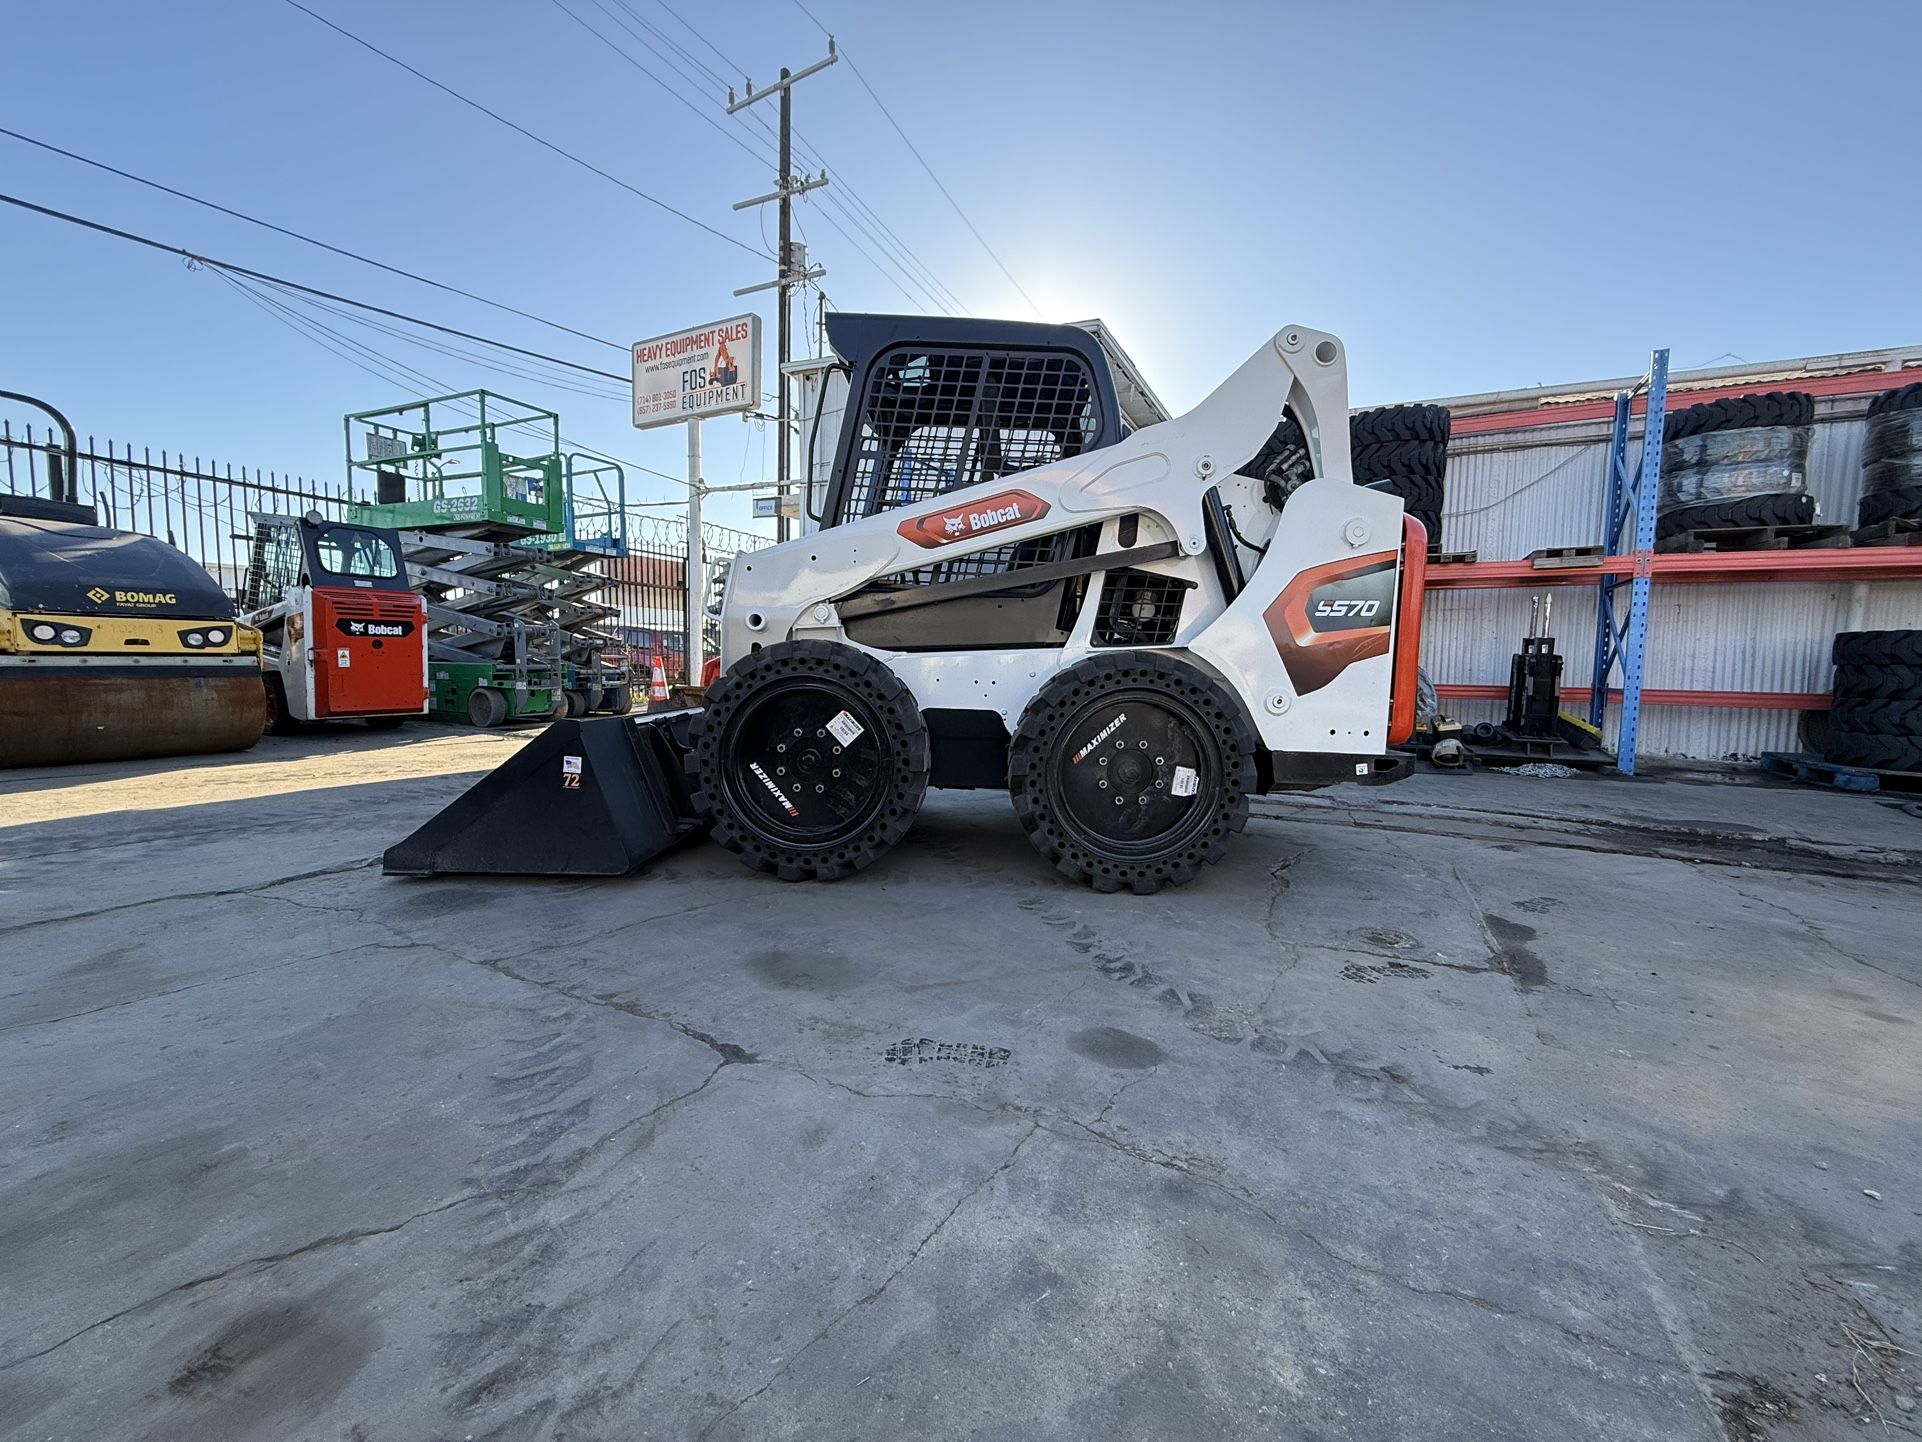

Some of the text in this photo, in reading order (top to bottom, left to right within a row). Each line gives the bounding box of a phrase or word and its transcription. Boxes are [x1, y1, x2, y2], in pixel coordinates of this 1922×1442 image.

[636, 322, 748, 364] HEAVY EQUIPMENT SALES
[645, 352, 709, 373] www.fosequipment.com
[682, 367, 706, 392] FOS
[637, 393, 651, 406] (714)
[682, 384, 746, 410] EQUIPMENT
[433, 497, 478, 513] GS-2632
[968, 502, 1021, 530] Bobcat
[115, 591, 176, 604] BOMAG
[1315, 600, 1380, 616] S570
[368, 624, 403, 636] Bobcat
[1079, 713, 1127, 758] MAXIMIZER
[563, 773, 580, 787] 72
[749, 762, 793, 809] MAXIMIZER
